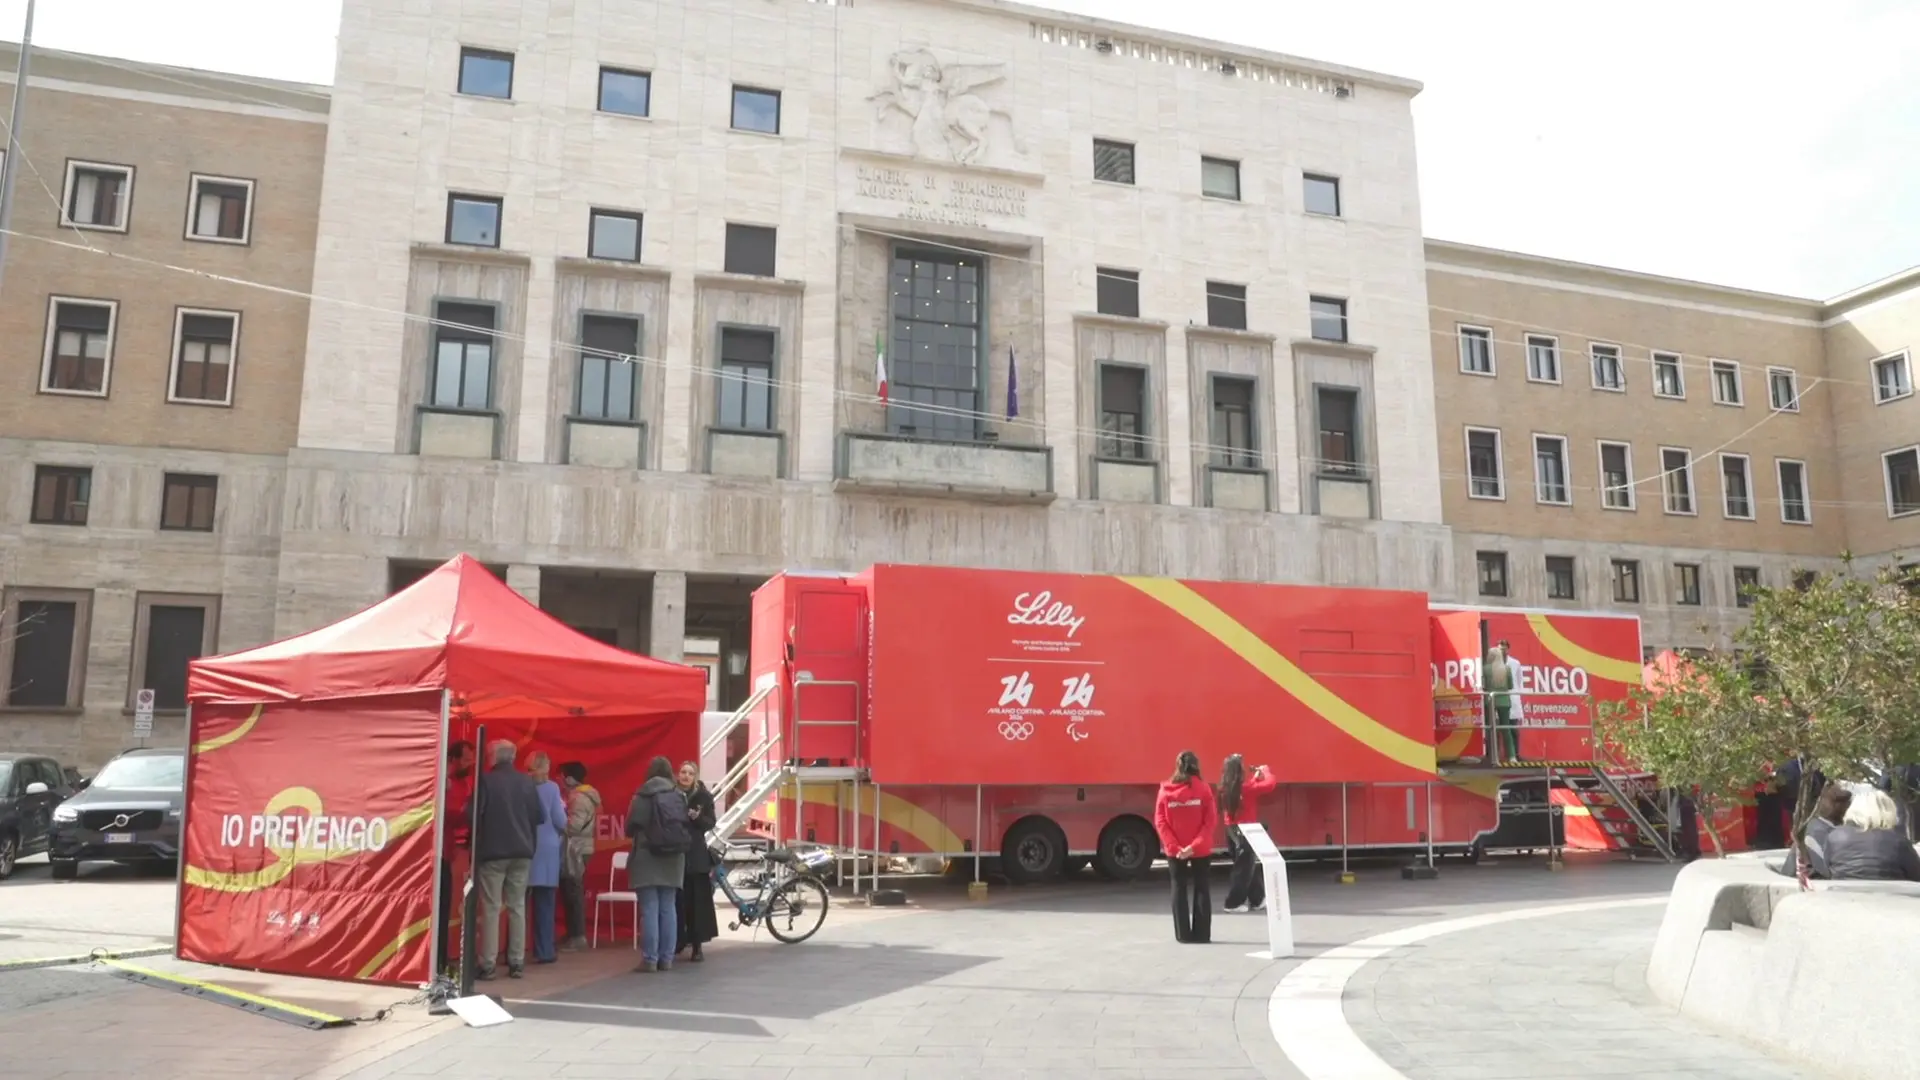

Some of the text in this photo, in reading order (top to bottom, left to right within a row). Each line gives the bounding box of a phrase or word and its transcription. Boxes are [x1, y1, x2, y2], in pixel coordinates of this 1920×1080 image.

[1007, 590, 1086, 638] Lilly
[221, 814, 388, 852] IO PREVENGO
